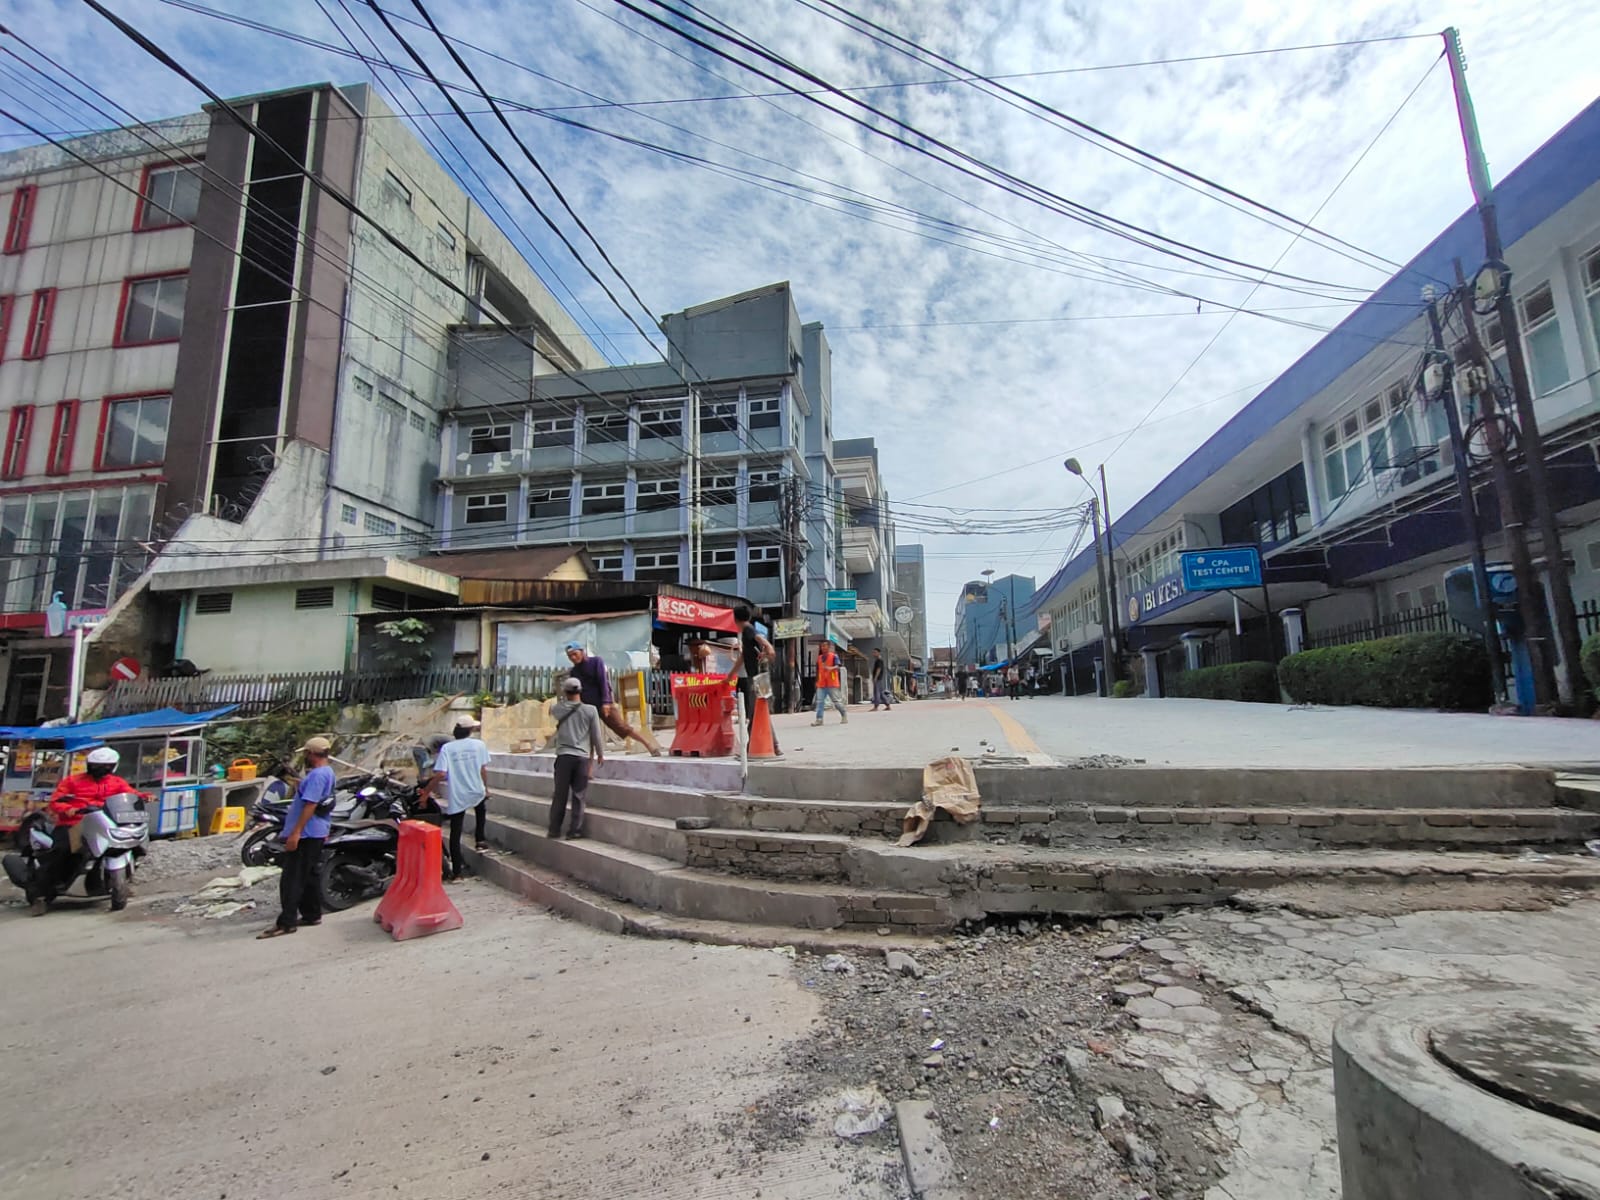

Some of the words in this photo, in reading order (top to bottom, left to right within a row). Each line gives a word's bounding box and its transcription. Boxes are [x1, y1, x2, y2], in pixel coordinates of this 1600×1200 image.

[1211, 559, 1229, 567] CPA
[1192, 568, 1213, 577] TEST
[1215, 565, 1250, 575] CENTER
[670, 600, 696, 618] SRC
